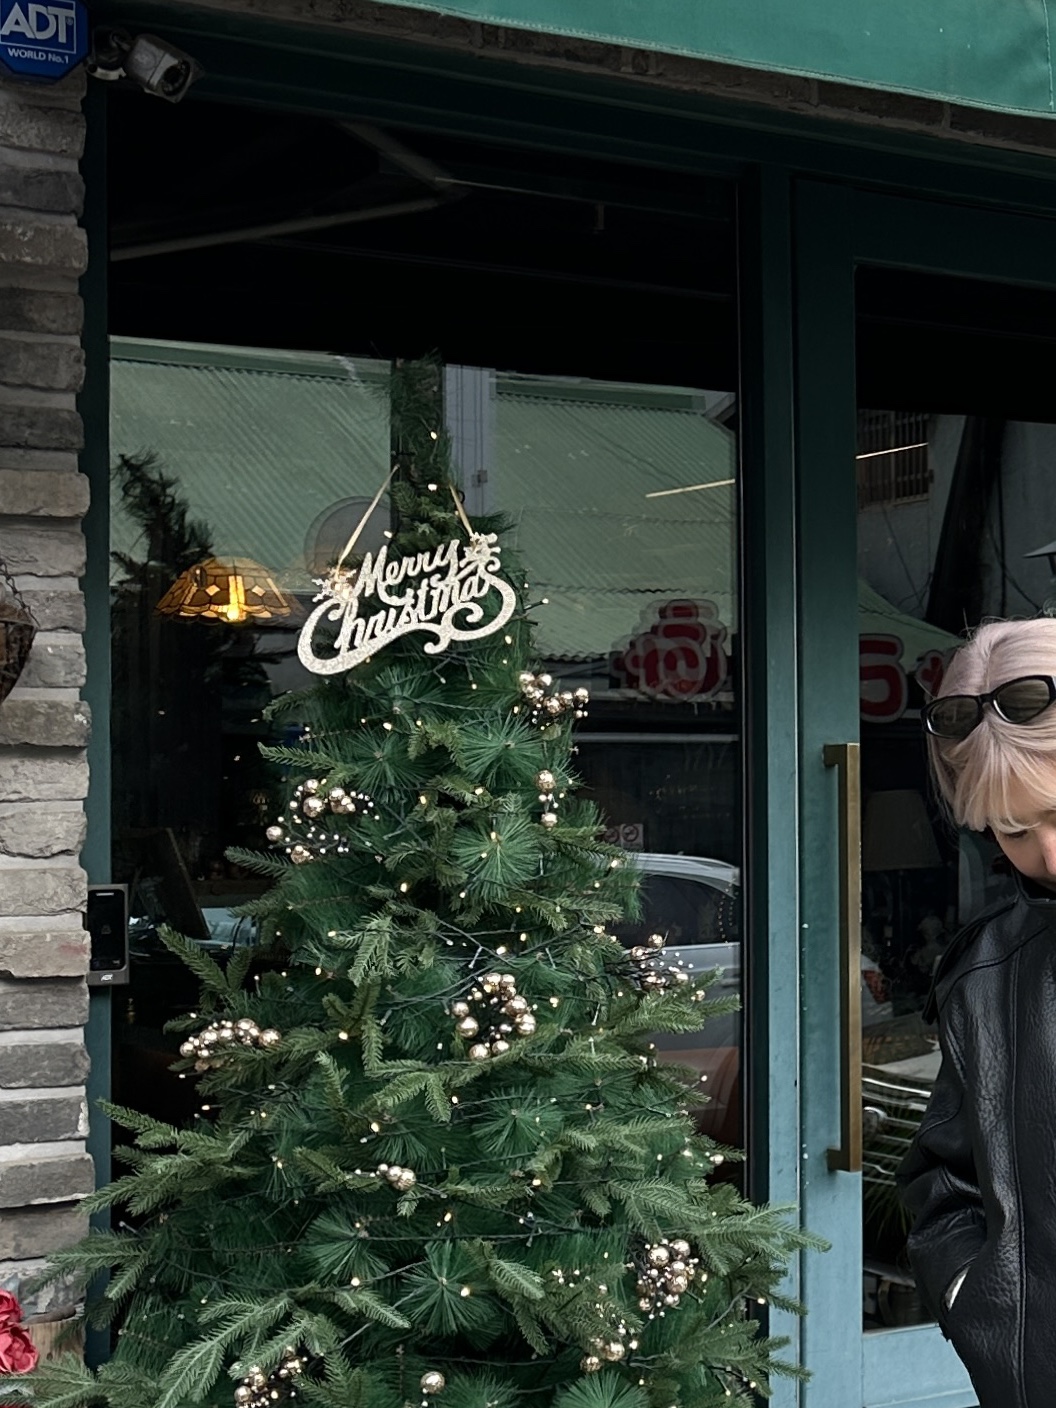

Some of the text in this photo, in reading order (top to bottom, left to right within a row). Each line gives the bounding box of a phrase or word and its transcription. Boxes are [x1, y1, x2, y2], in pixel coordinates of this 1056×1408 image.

[0, 2, 75, 44] ADT
[7, 47, 69, 65] WORLD No.1
[352, 538, 464, 604] Merry
